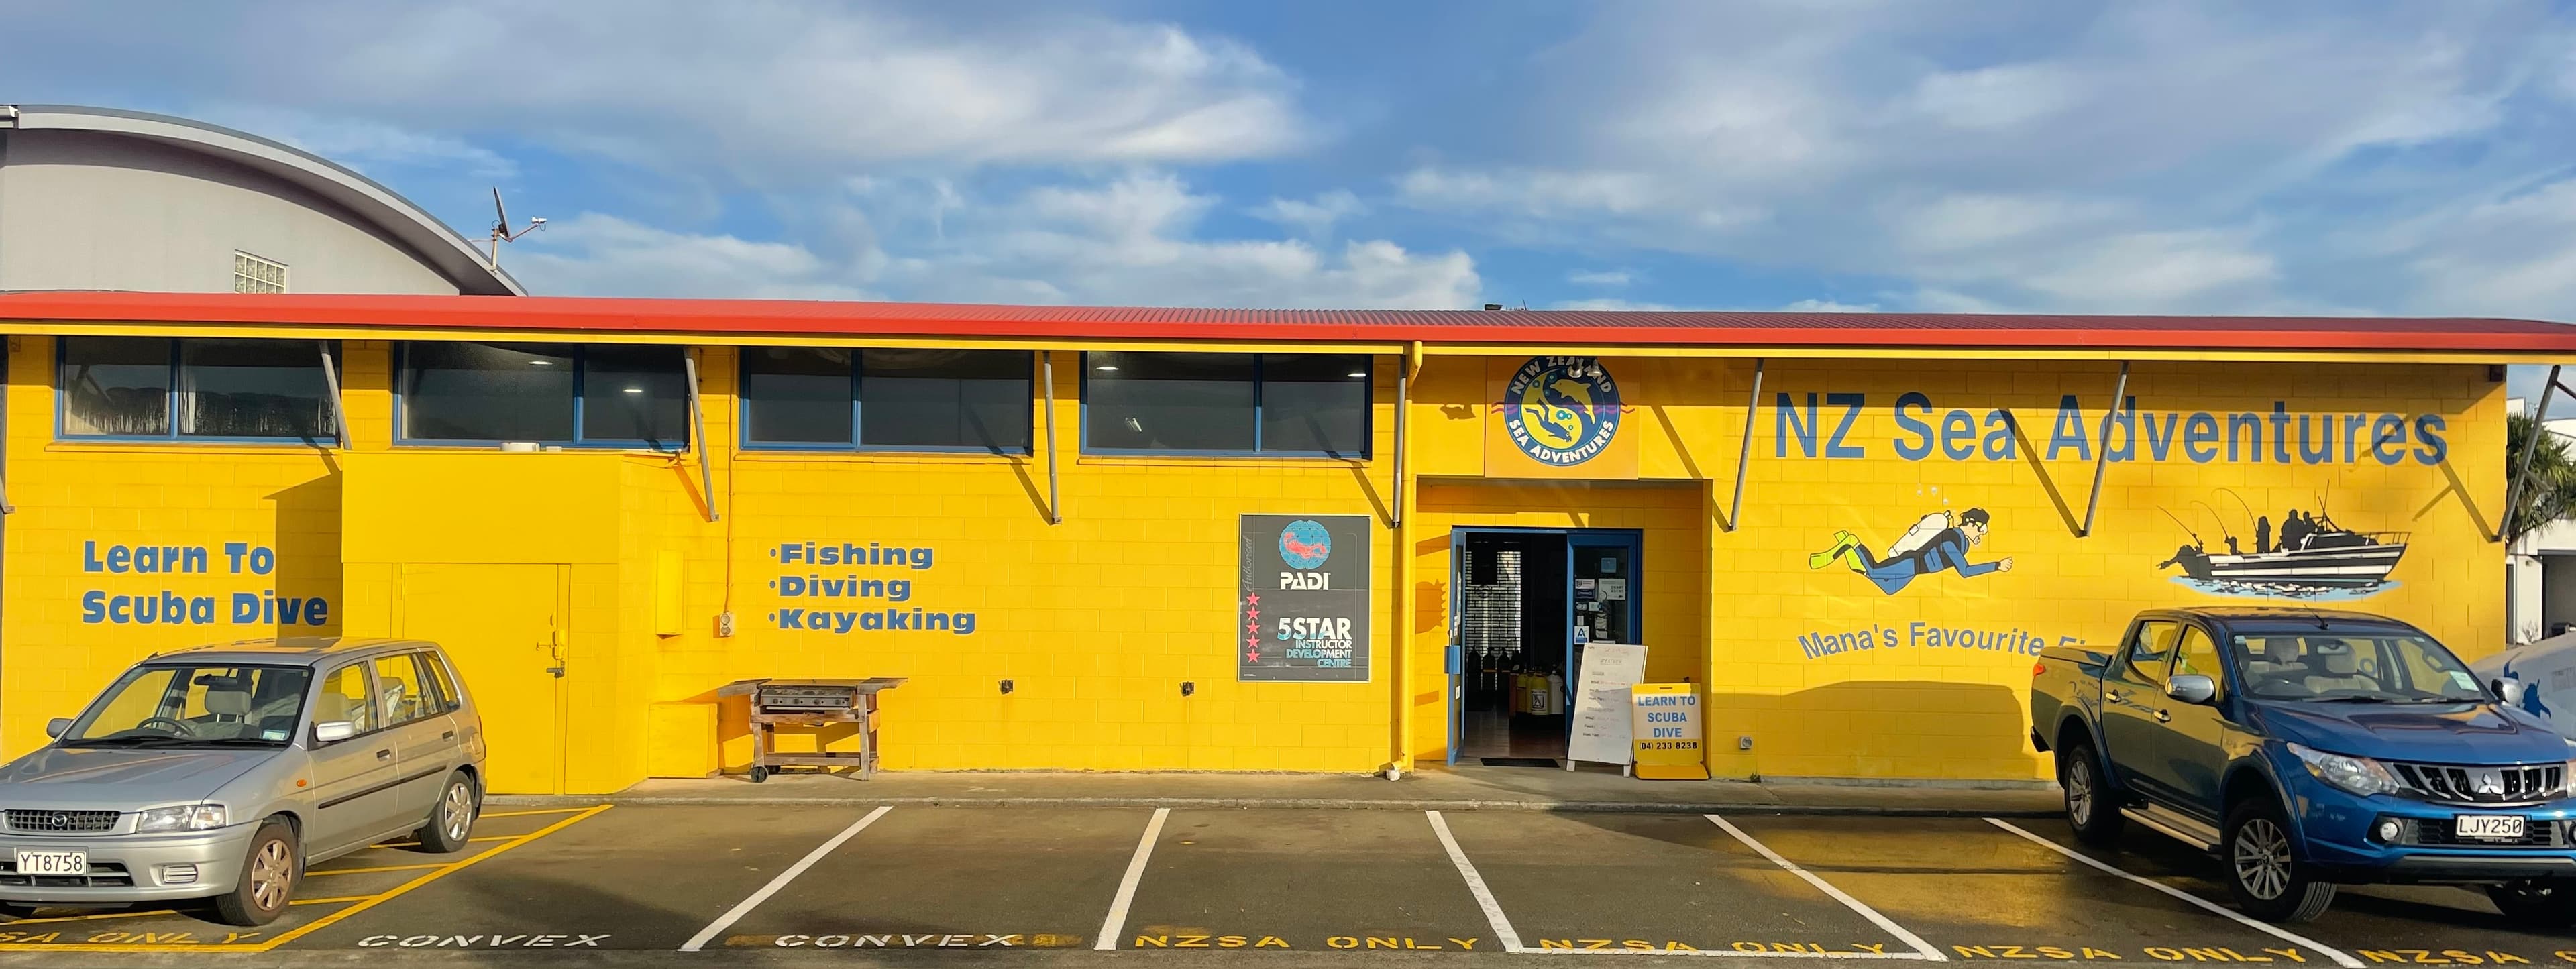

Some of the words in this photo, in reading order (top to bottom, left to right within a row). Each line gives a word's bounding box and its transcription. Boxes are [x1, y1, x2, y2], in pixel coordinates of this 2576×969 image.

[1511, 361, 1541, 395] NEW
[1776, 392, 1865, 458] NZ
[1893, 392, 2016, 461] Sea
[2046, 394, 2449, 466] Adventures
[1509, 419, 1529, 447] SEA
[1529, 420, 1614, 463] ADVENTURES
[84, 540, 207, 573] Learn
[225, 543, 274, 575] To
[780, 542, 934, 569] Fishing
[779, 574, 911, 602] Diving
[1280, 572, 1329, 591] PADI
[83, 590, 215, 624] Scuba
[232, 590, 329, 626] Dive
[778, 608, 976, 635] Kayaking
[1295, 640, 1352, 649] INSTRUCTOR
[1797, 624, 1898, 659] Mana's
[1909, 622, 2045, 657] Favourite
[1286, 649, 1352, 659] DEVELOPMENT
[1317, 659, 1352, 668] CENTRE
[1638, 696, 1676, 706] LEARN
[1680, 696, 1696, 705] TO
[1648, 712, 1687, 722] SCUBA
[1653, 728, 1682, 738] DIVE
[1639, 742, 1654, 750] (04)
[1676, 742, 1697, 750] 8238
[2459, 819, 2522, 834] LJY250
[21, 854, 83, 872] YT8758
[88, 932, 261, 944] ONLY
[358, 934, 611, 947] CONVEX
[775, 934, 1015, 947] CONVEX
[1135, 935, 1290, 948] NZSA
[1327, 935, 1479, 950] ONLY
[1540, 939, 1699, 952] NZSA
[1731, 942, 1884, 955] ONLY
[1952, 945, 2121, 960] NZSA
[2144, 946, 2306, 962] ONLY
[2355, 950, 2530, 964] NZSA
